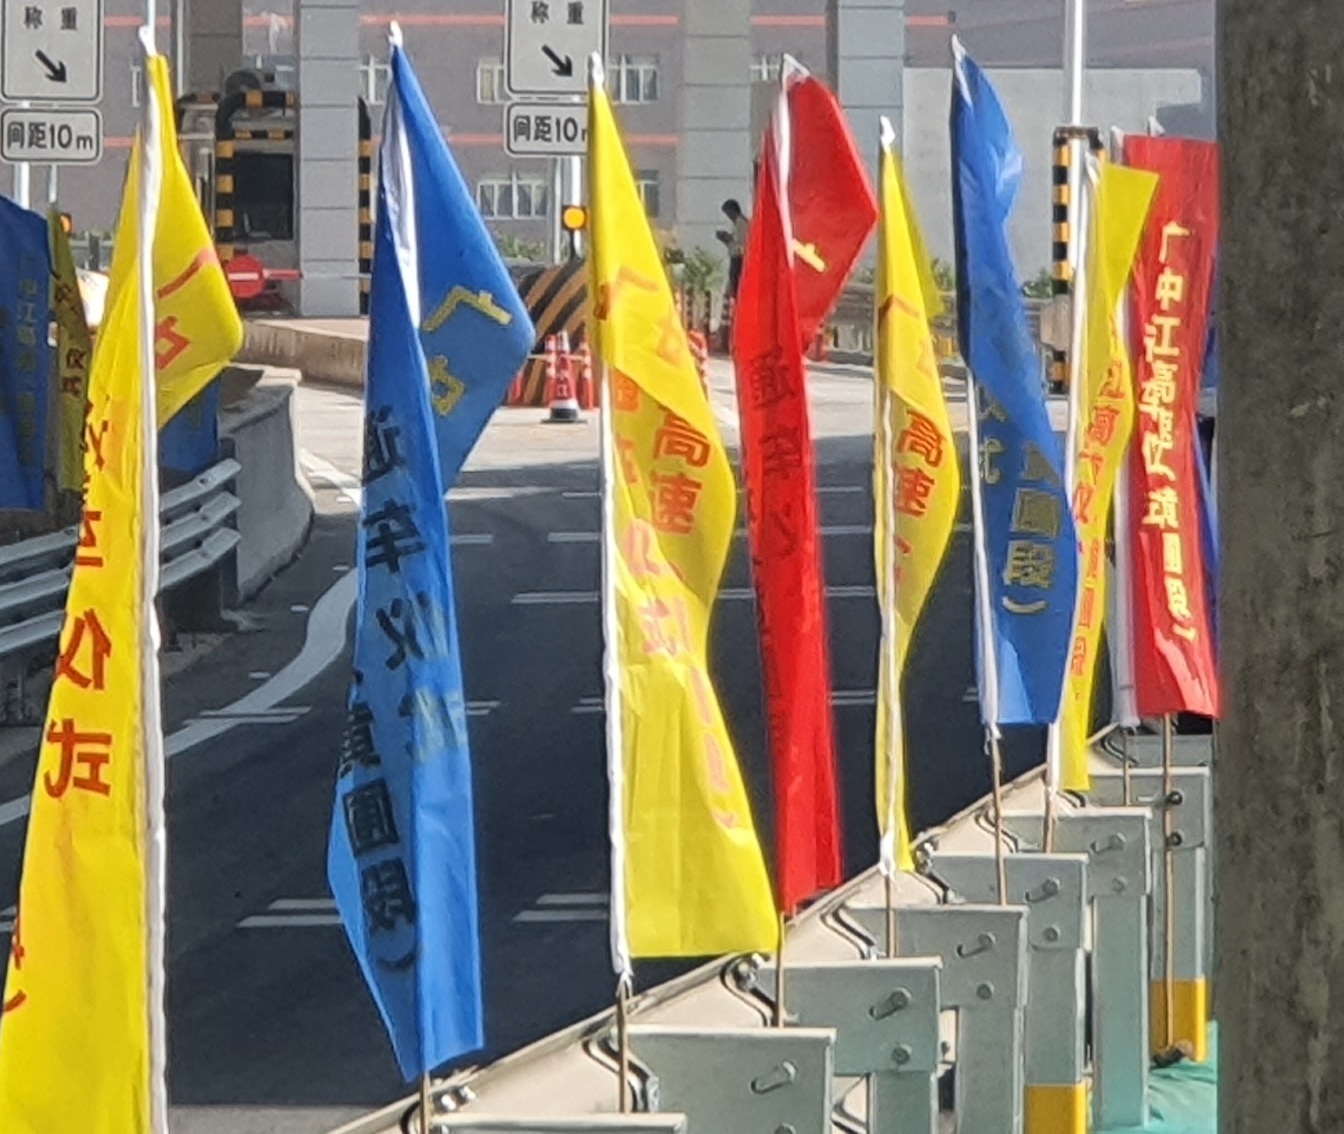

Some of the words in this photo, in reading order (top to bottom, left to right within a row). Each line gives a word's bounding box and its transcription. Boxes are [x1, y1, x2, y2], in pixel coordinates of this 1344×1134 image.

[24, 6, 78, 31] 称重
[530, 1, 585, 25] 称重
[513, 115, 588, 143] 间距10
